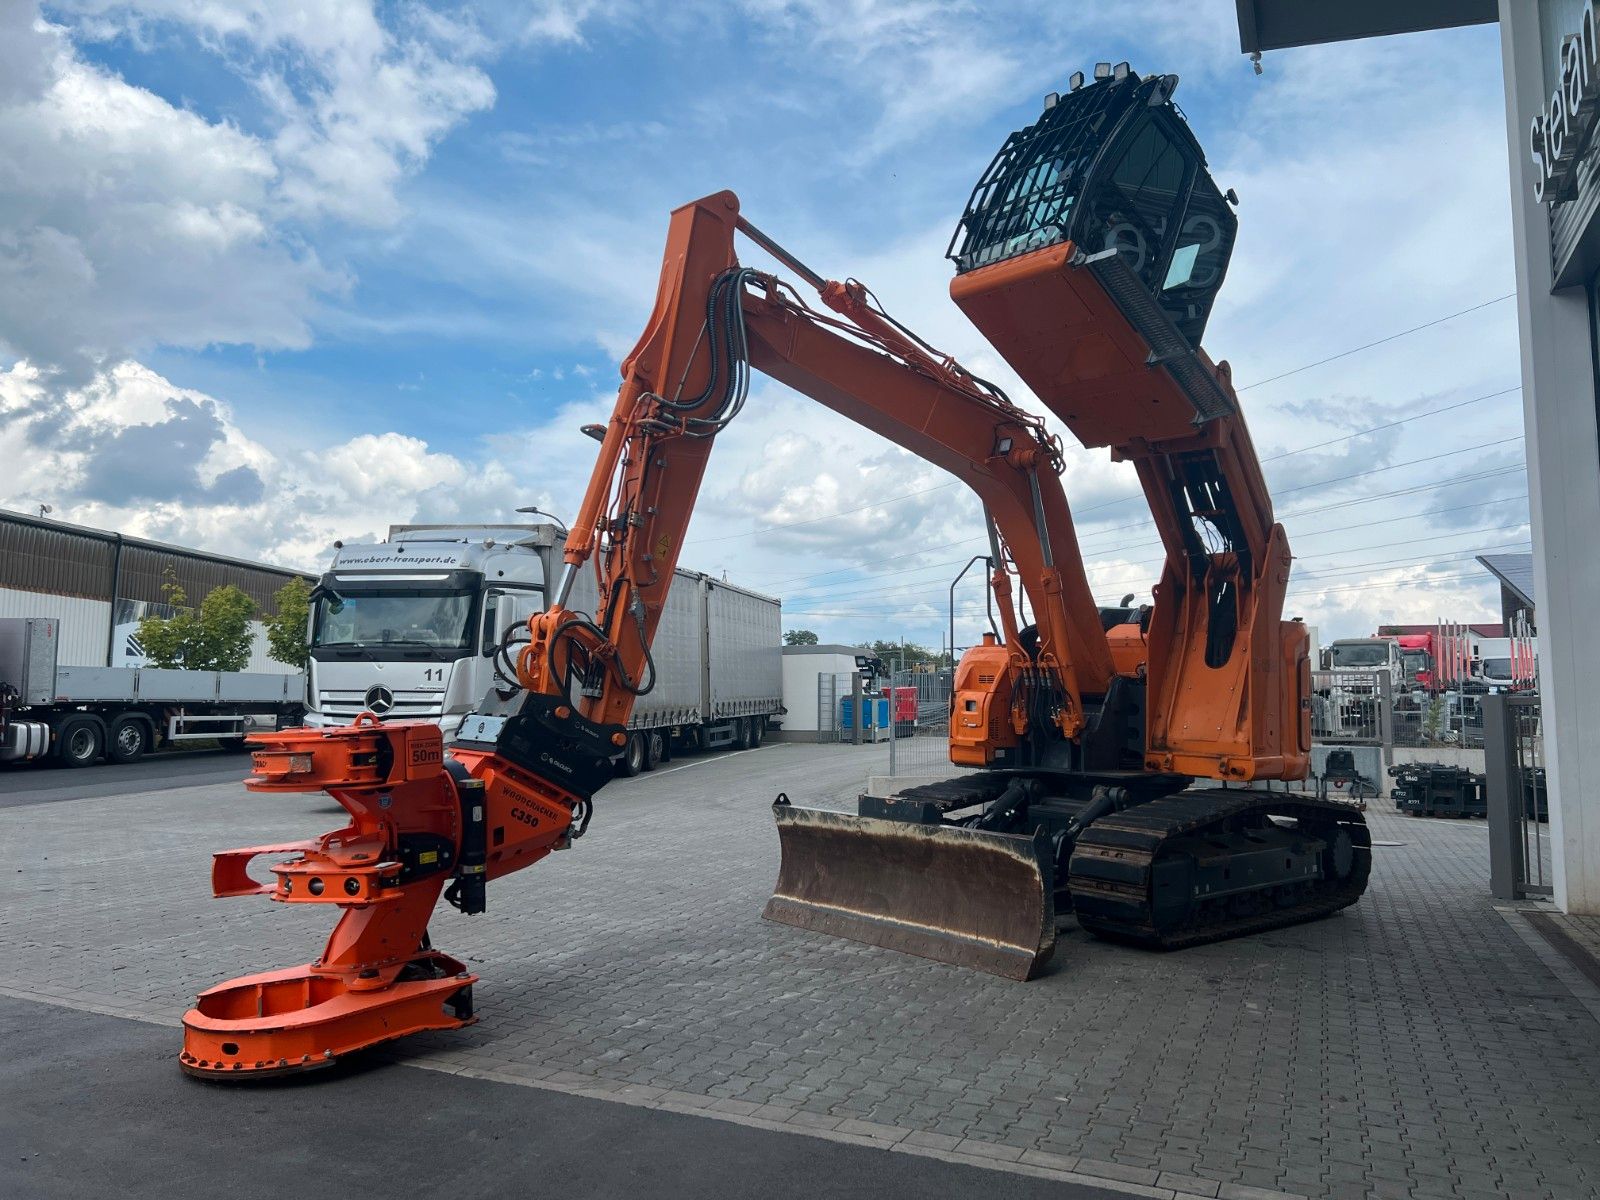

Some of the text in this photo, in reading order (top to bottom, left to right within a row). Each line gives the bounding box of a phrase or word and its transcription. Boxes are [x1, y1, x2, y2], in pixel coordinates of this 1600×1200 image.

[1530, 0, 1598, 204] Stefan
[339, 556, 457, 565] www.ebert-transport.de
[424, 668, 443, 681] 11
[413, 749, 439, 762] 50m
[510, 807, 539, 828] C350
